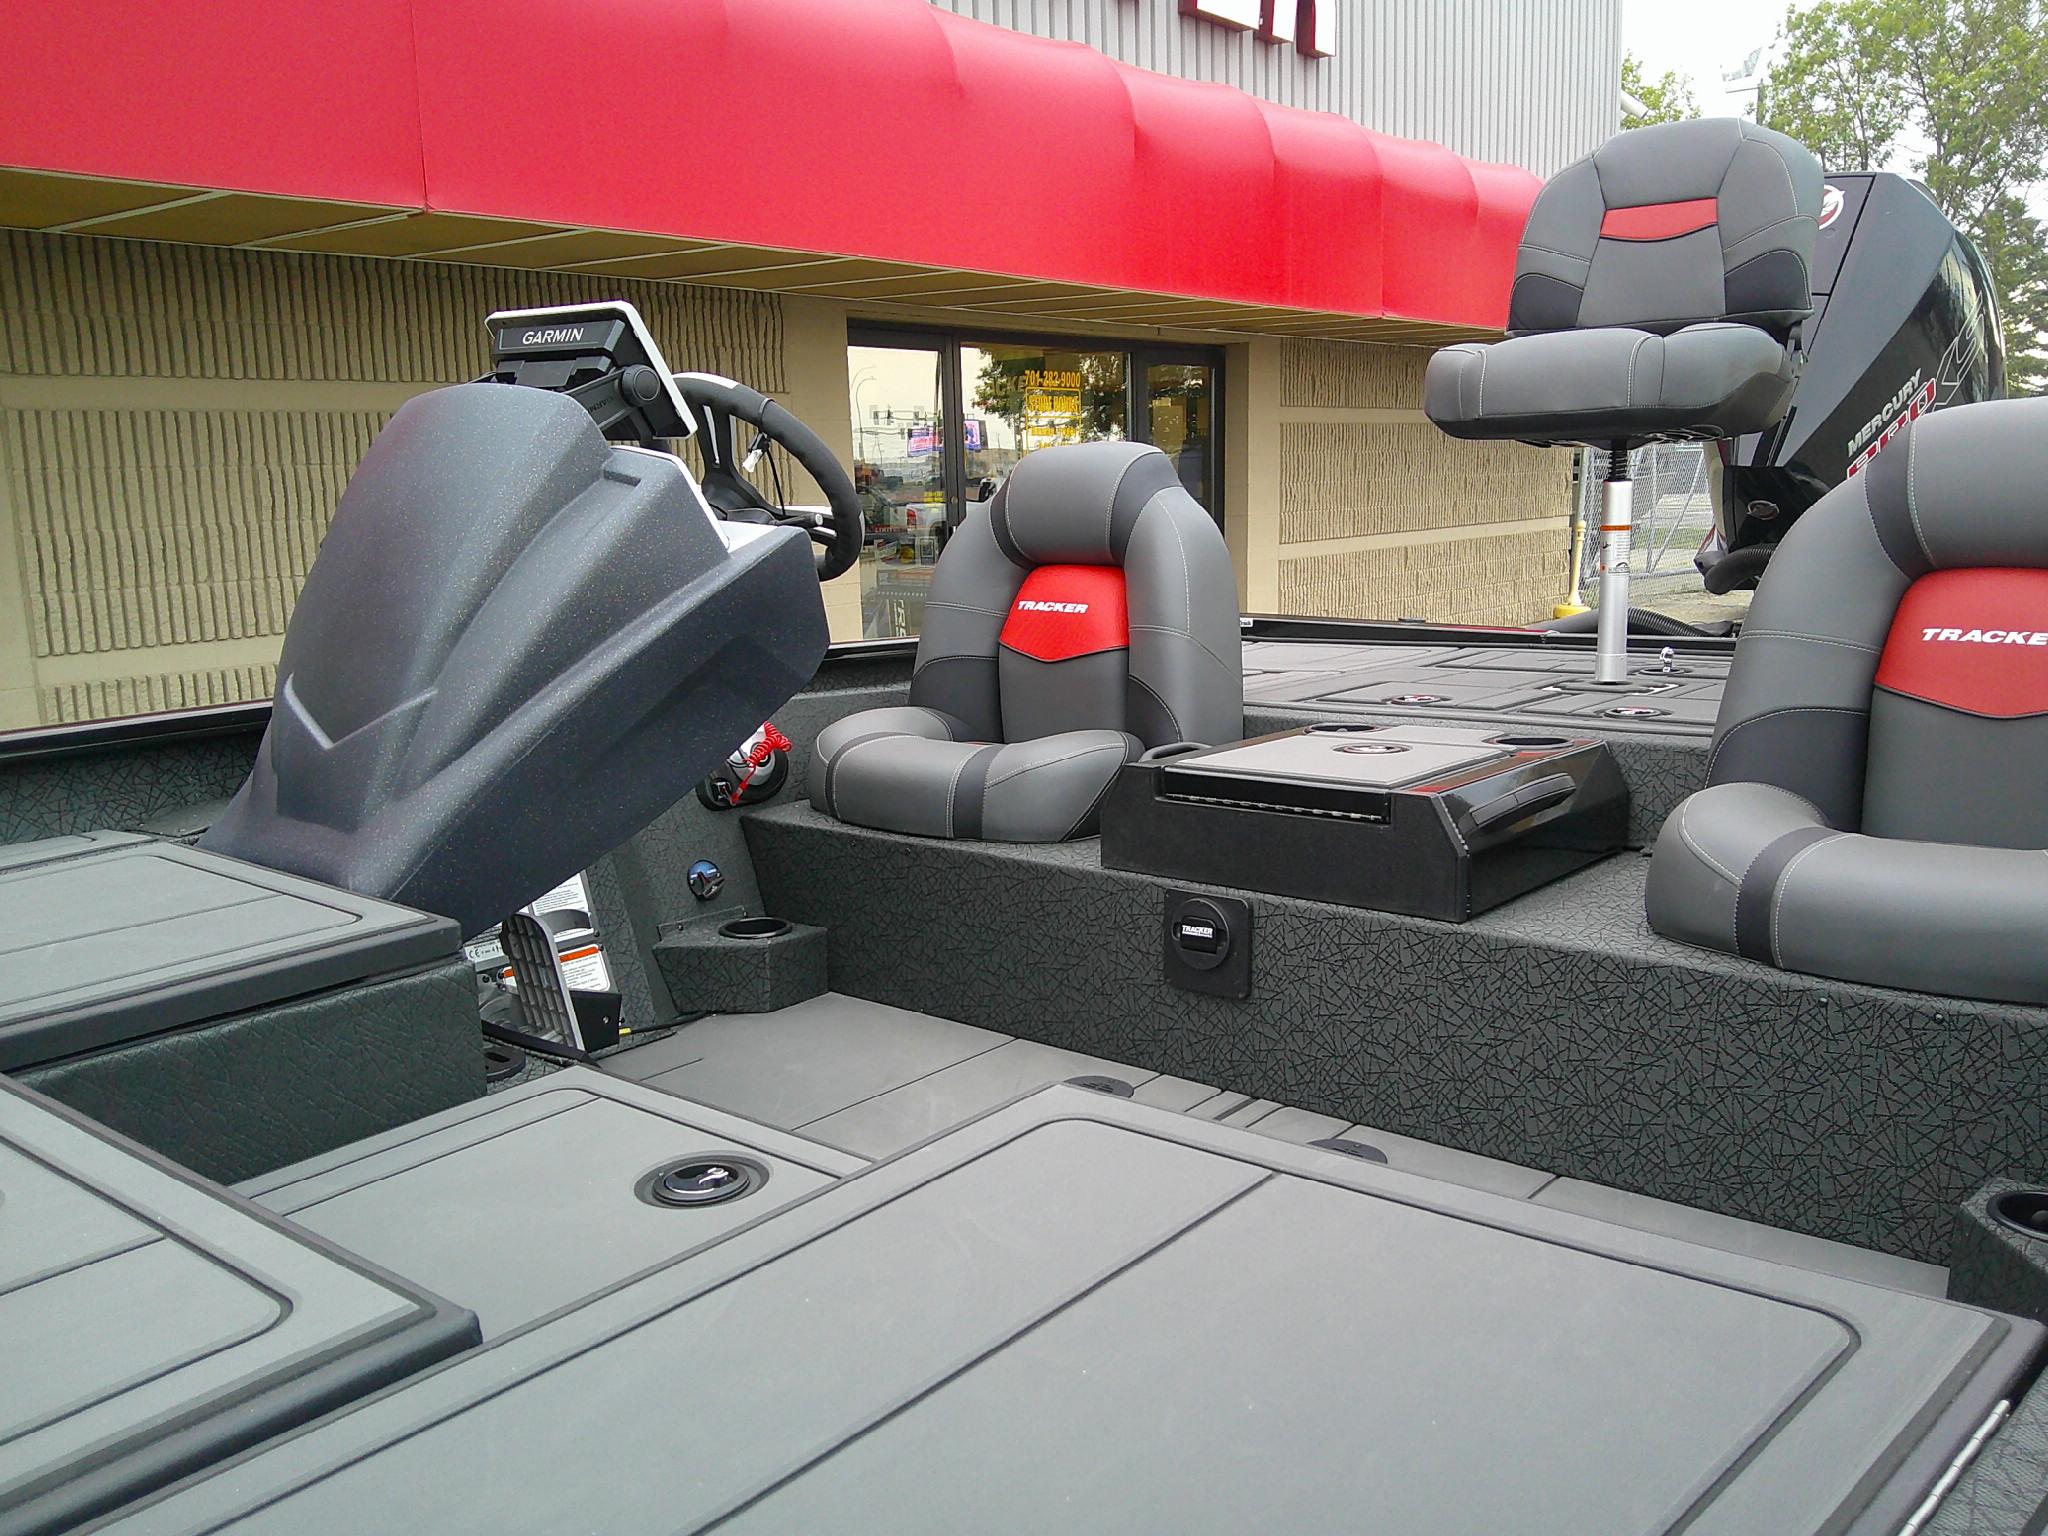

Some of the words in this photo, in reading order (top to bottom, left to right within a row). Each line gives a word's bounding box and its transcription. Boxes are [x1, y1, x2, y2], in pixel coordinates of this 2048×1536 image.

[522, 327, 584, 345] GARMIN
[1025, 370, 1081, 387] 701-282-9000
[1847, 367, 1922, 457] MERCURY
[1017, 600, 1088, 614] TRACKER
[1181, 925, 1213, 935] TRACKER
